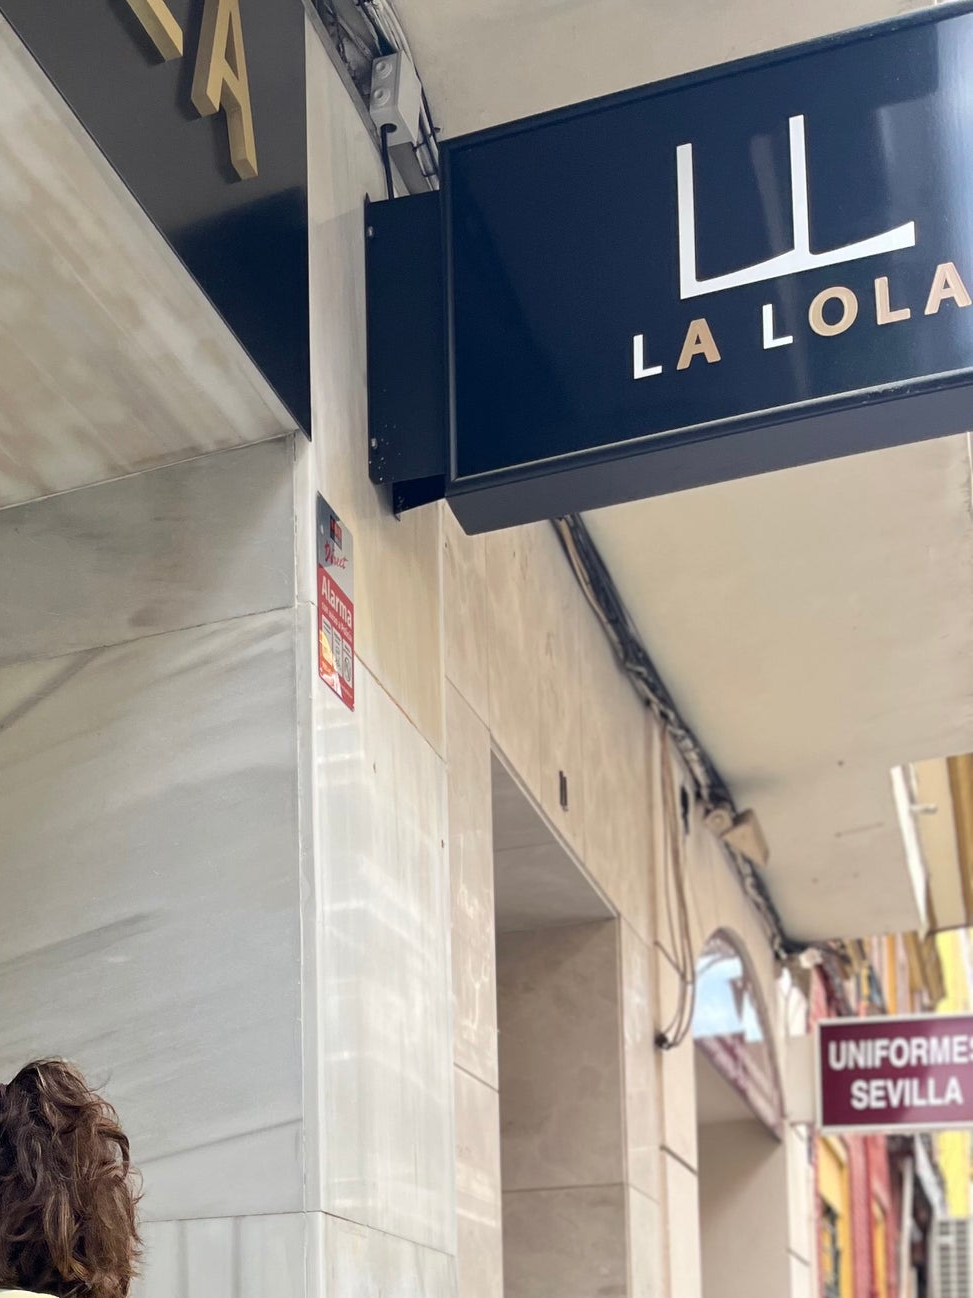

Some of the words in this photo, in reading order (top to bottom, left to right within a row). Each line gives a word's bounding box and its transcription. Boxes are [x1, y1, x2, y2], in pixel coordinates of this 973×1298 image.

[633, 318, 721, 380] LA
[762, 262, 972, 350] LOLA
[322, 575, 353, 629] Alarma
[828, 1035, 973, 1071] UNIFORME
[850, 1077, 964, 1110] SEVILLA
